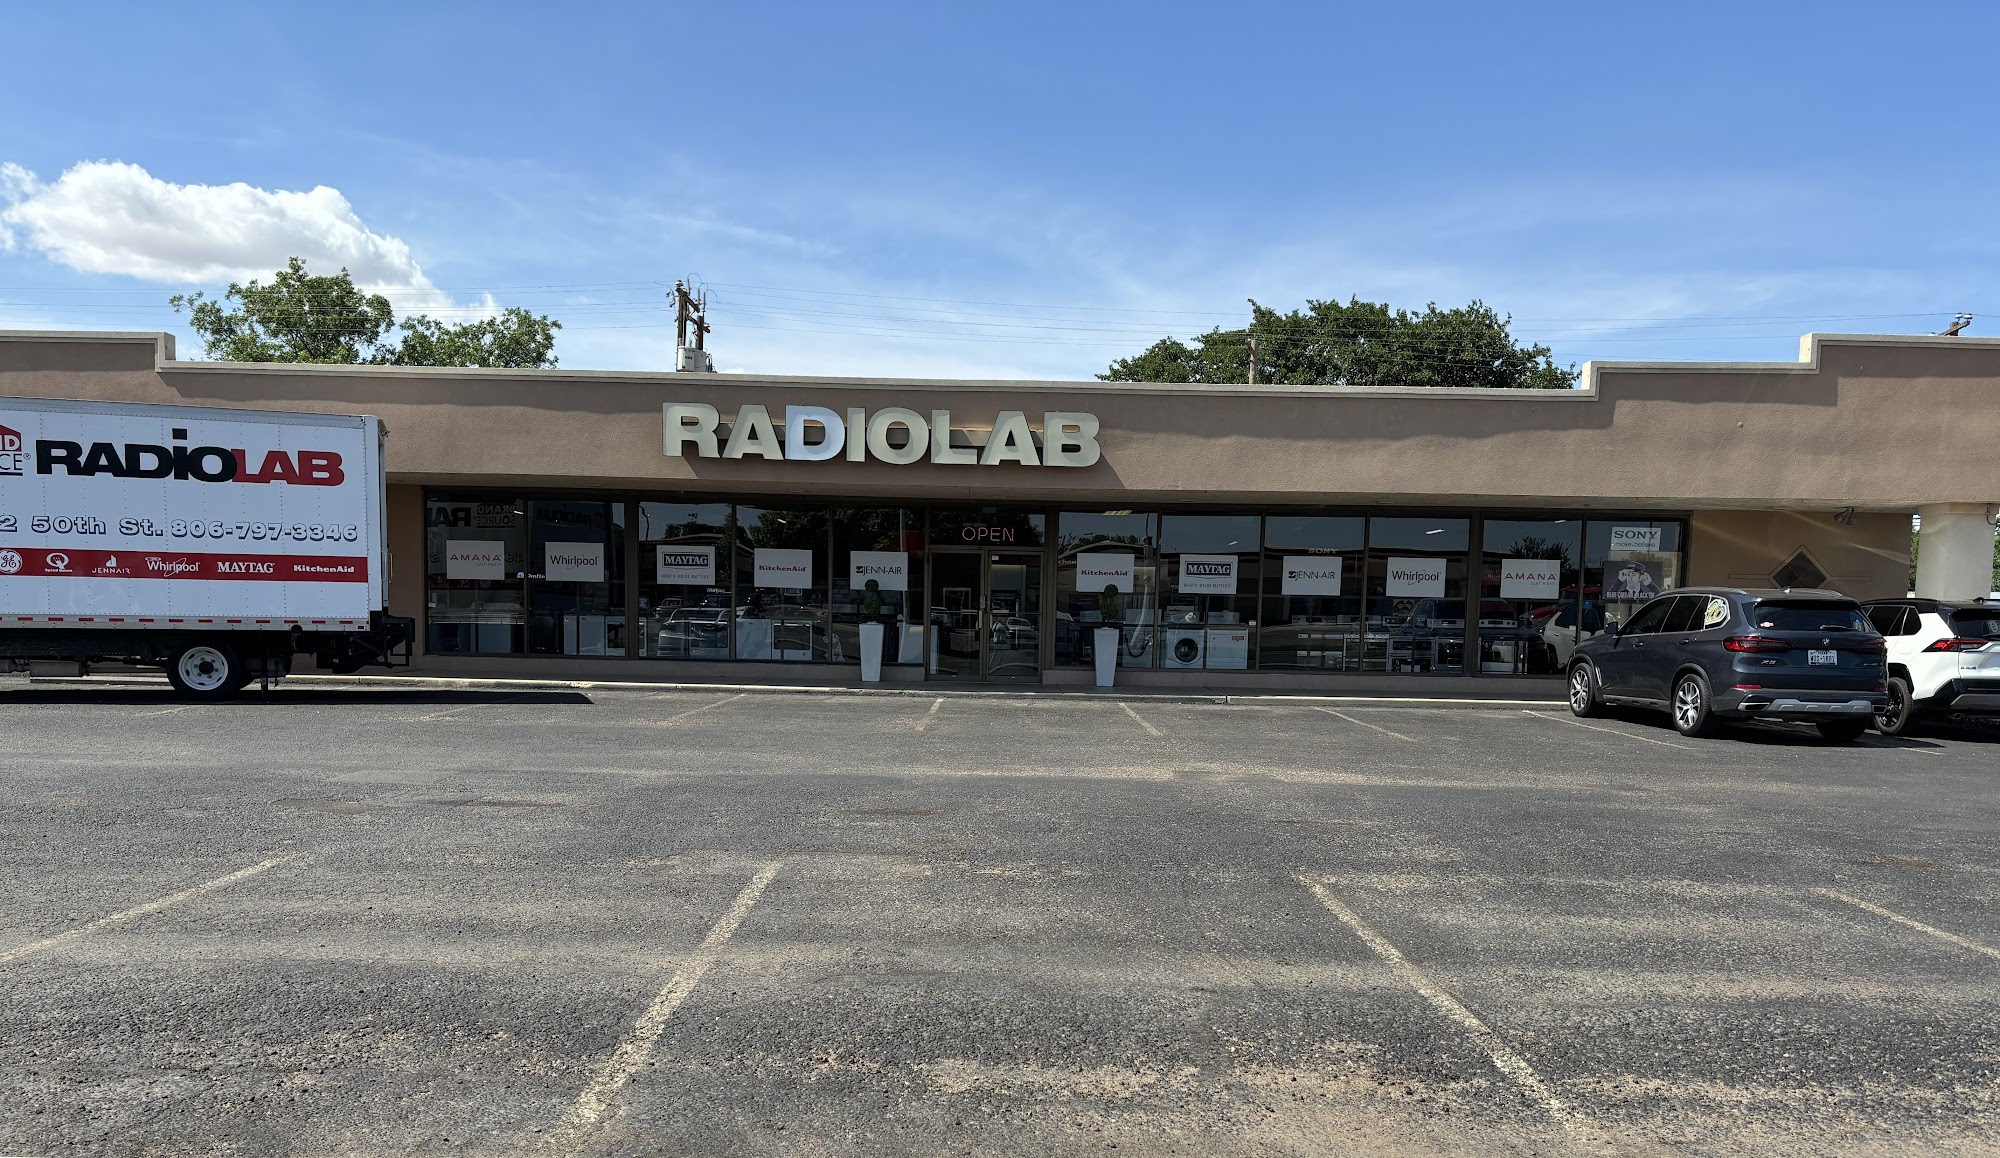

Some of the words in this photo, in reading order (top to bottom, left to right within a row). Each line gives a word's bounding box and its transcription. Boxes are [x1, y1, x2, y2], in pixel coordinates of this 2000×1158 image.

[662, 402, 1101, 467] RADIOLAB
[31, 516, 107, 535] 50th
[119, 518, 163, 537] St.
[171, 519, 358, 542] 806-797-3346
[962, 526, 1014, 542] OPEN
[1614, 530, 1659, 539] SONY
[550, 554, 599, 567] Whirlpool
[665, 556, 707, 565] MAYTAG
[146, 559, 199, 574] Whirlpool
[217, 562, 274, 573] MAYTAG
[294, 565, 355, 573] KitchenAid
[758, 564, 806, 572] KitchenAid
[863, 566, 902, 576] JENN-AIR
[1187, 564, 1230, 574] MAYTAG
[1081, 569, 1129, 577] KitchenAid
[1295, 570, 1336, 581] JENN-AIR
[1391, 570, 1440, 583] Whirlpool
[1505, 572, 1556, 580] AMANA
